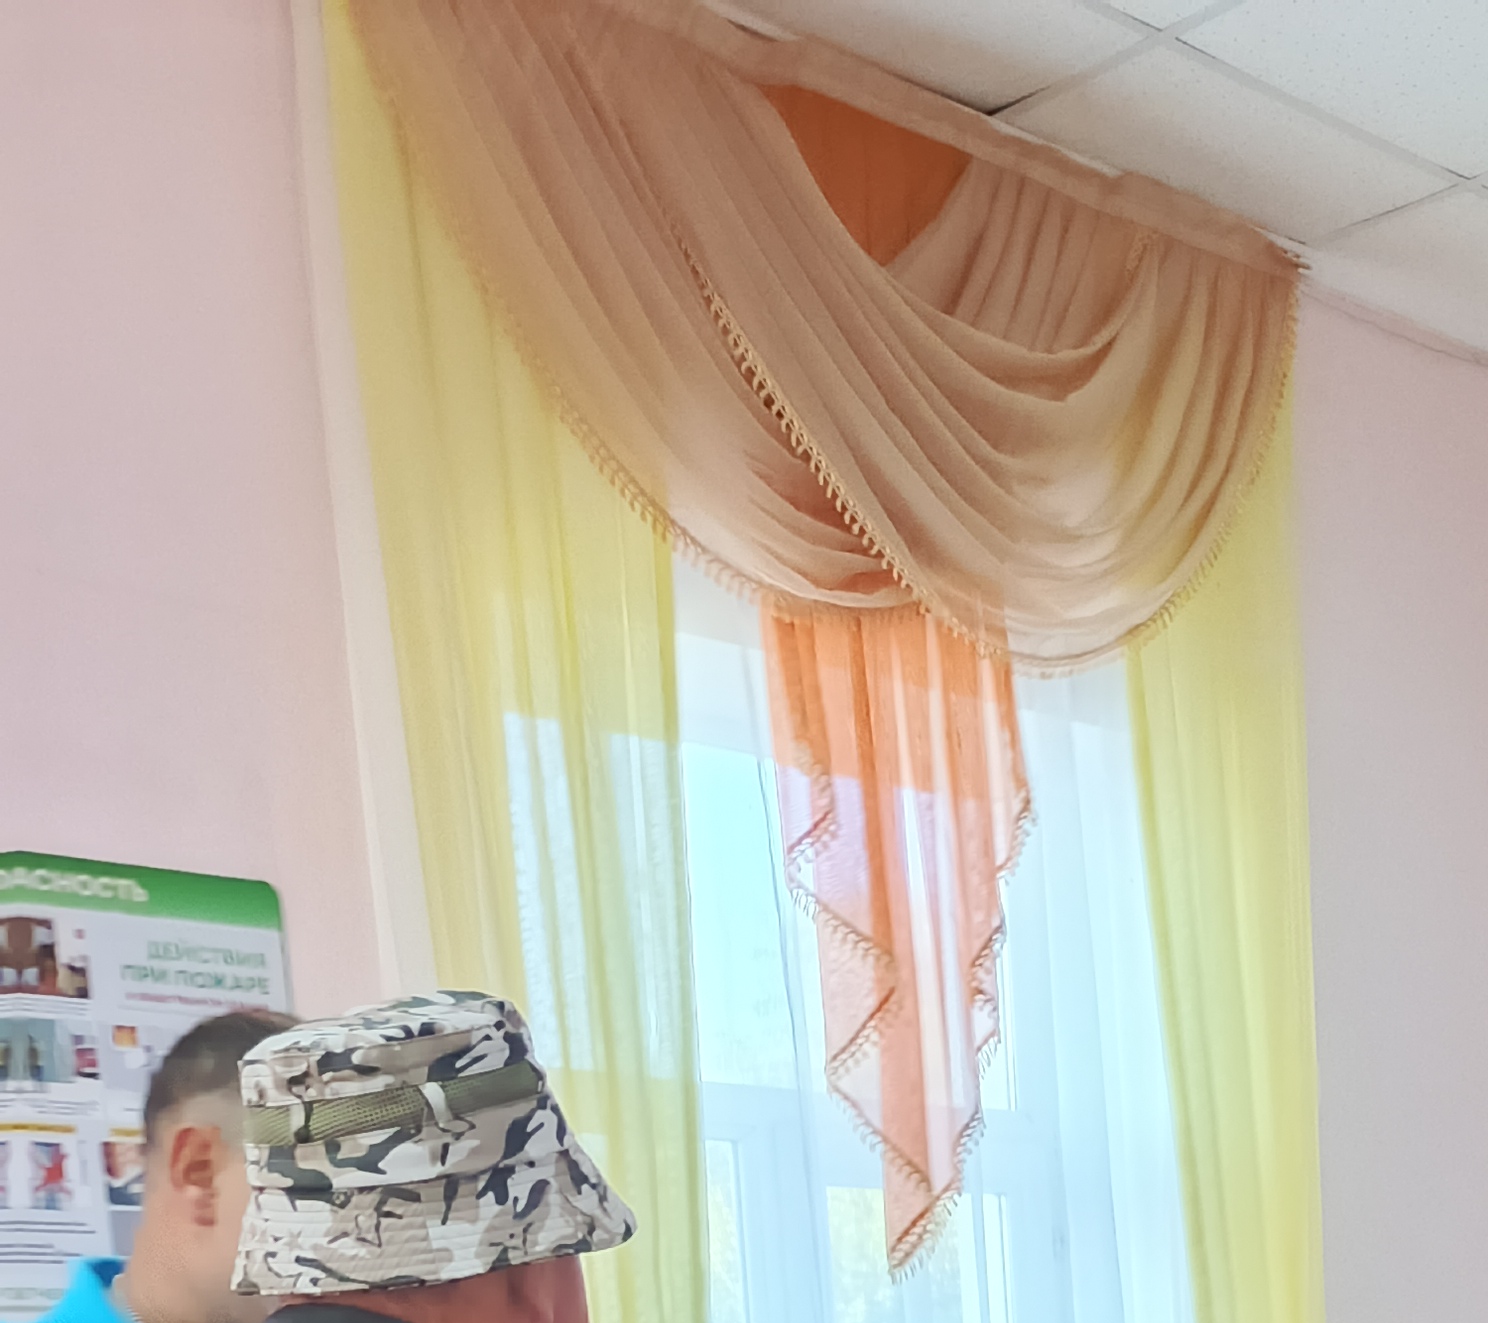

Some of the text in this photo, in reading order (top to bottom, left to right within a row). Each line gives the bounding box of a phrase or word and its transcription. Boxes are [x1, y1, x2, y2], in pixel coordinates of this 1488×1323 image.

[147, 938, 266, 969] ДЕЙСТВИЯ
[120, 964, 270, 995] ПРИ ПОЖАРЕ
